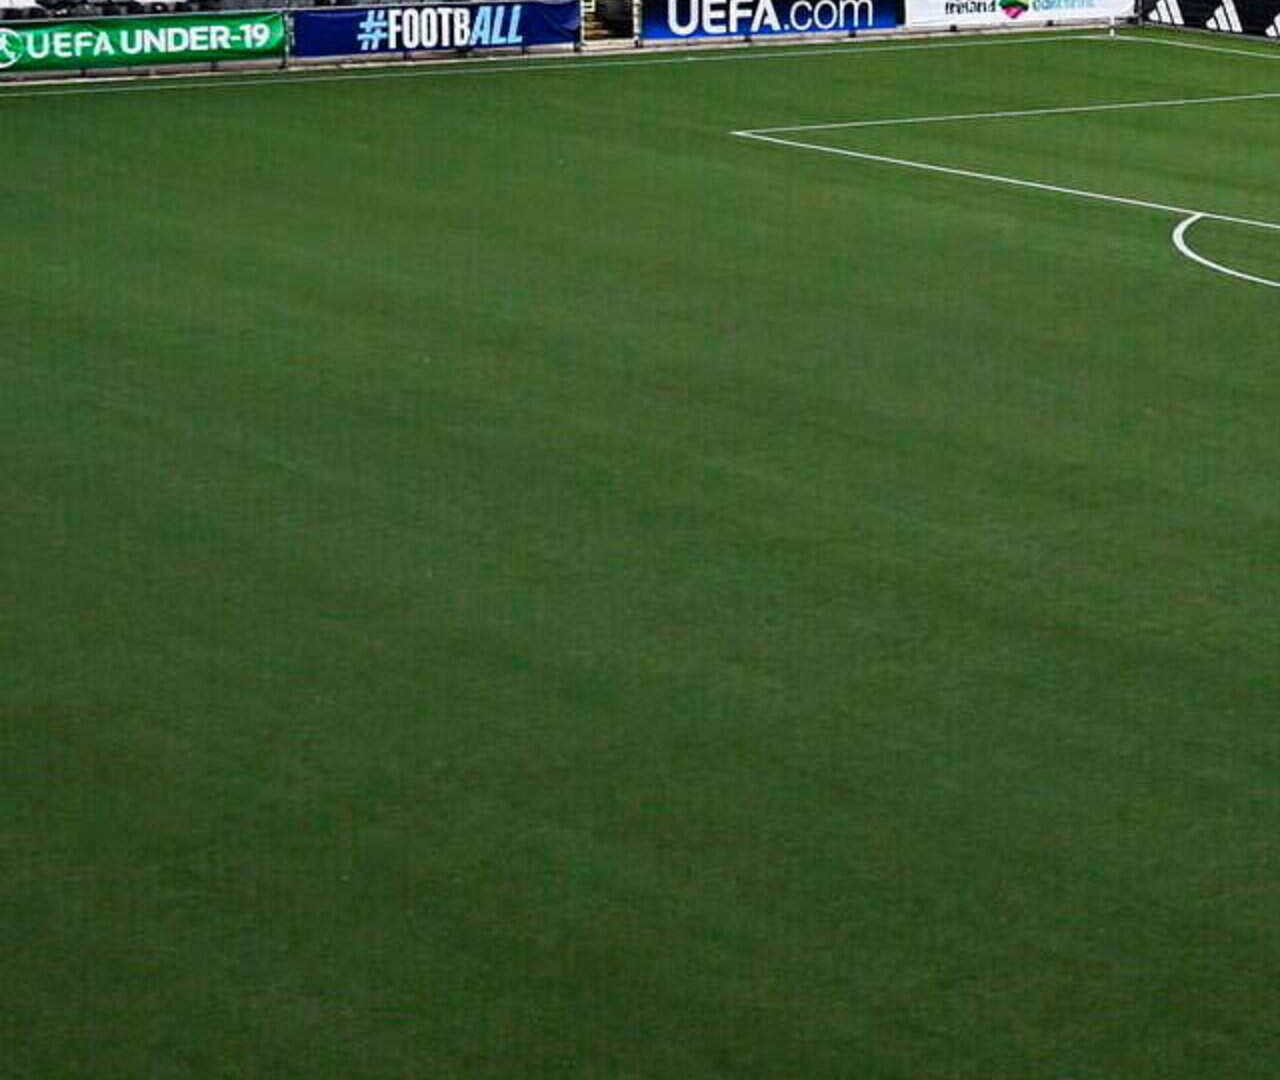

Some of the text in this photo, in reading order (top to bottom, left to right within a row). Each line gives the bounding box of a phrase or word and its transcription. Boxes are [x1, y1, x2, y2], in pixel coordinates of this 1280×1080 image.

[27, 22, 271, 60] UEFA UNDER-19
[357, 5, 523, 51] #FOOTBALL
